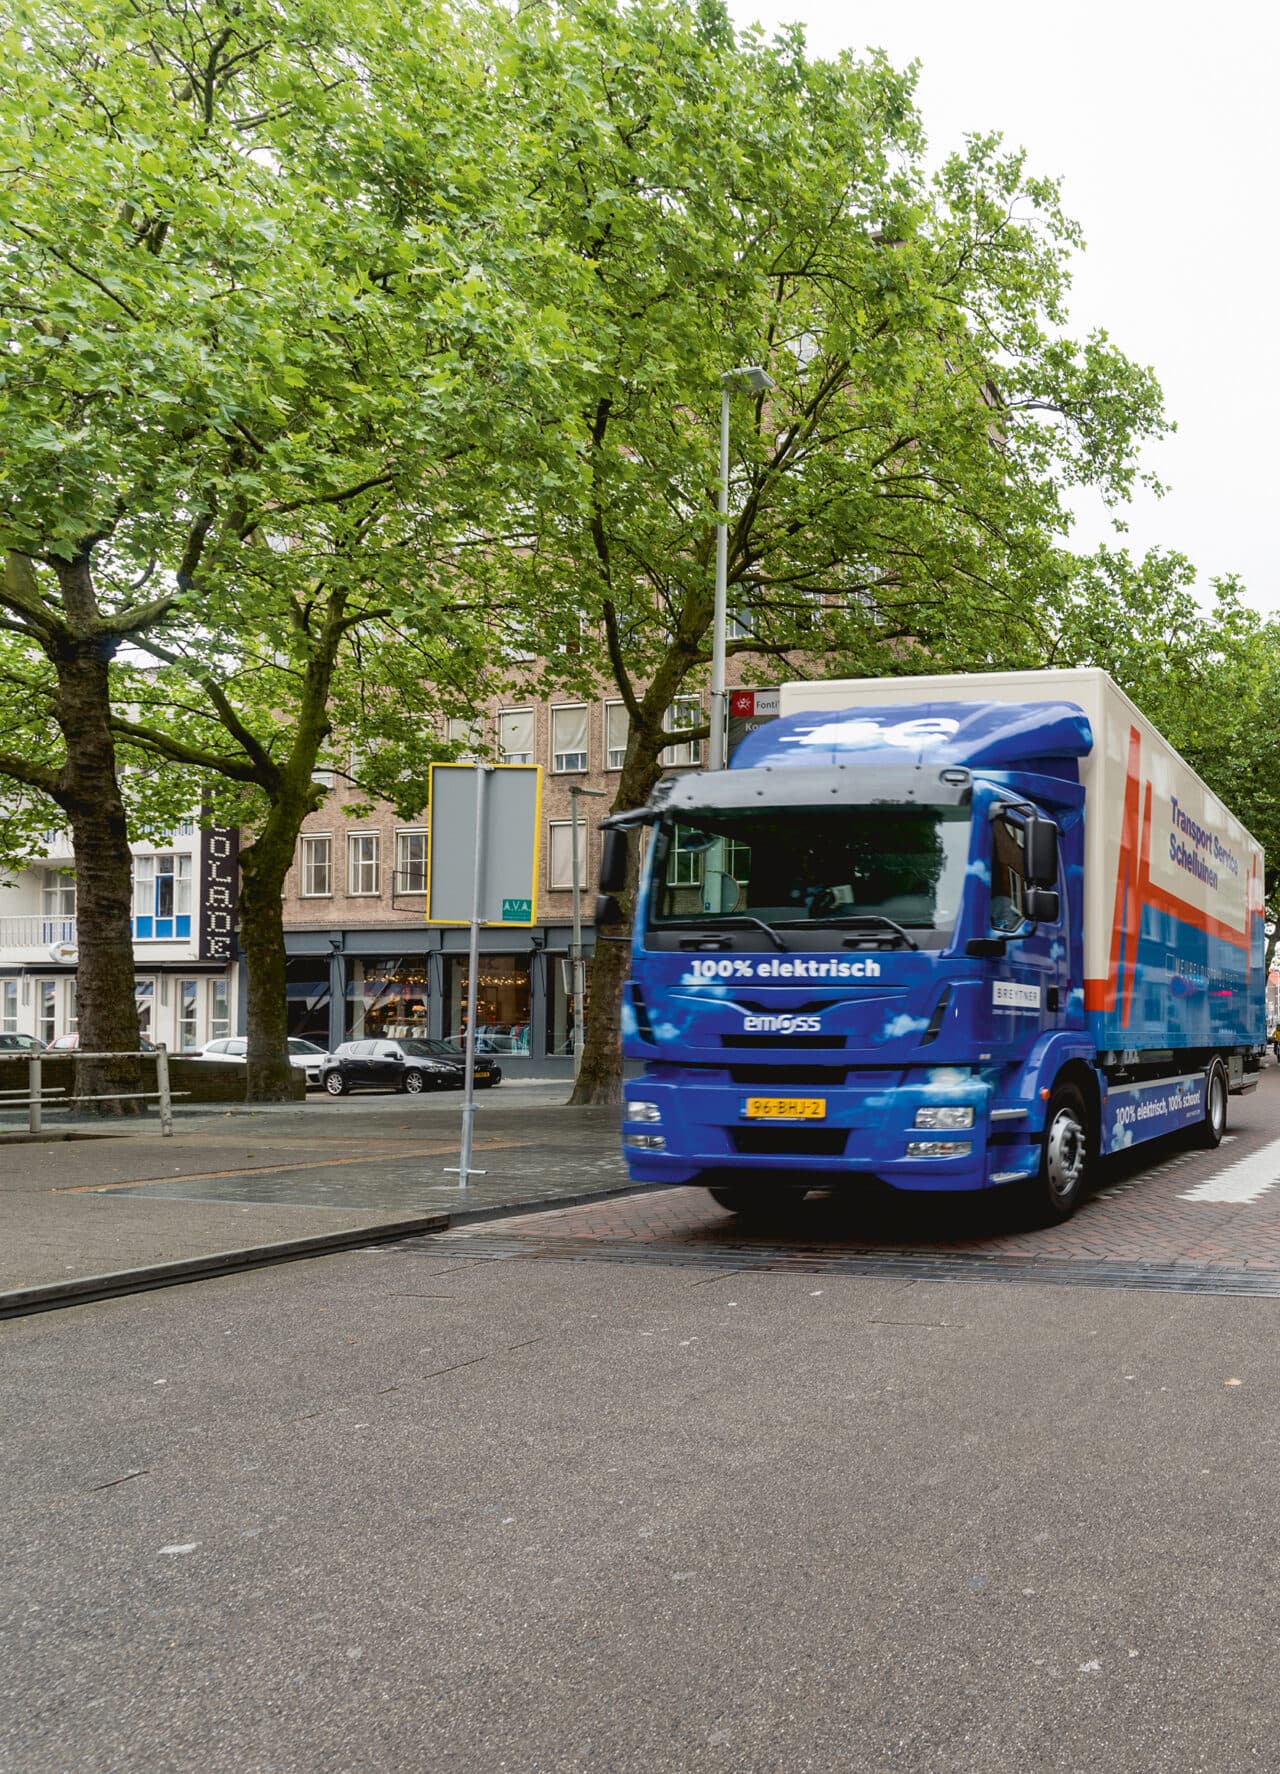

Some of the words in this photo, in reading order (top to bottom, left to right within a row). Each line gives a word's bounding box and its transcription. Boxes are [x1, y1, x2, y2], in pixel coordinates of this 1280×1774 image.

[756, 701, 780, 710] Fonti
[1170, 794, 1213, 856] Transport
[1213, 835, 1239, 877] Service
[1169, 831, 1218, 892] Schelluinen
[691, 959, 754, 977] 100%
[756, 959, 881, 977] elektrisch
[1116, 1104, 1136, 1125] 100%
[1137, 1098, 1168, 1121] elektrisch,
[1168, 1094, 1182, 1112] 100%
[1183, 1089, 1201, 1108] schoon!
